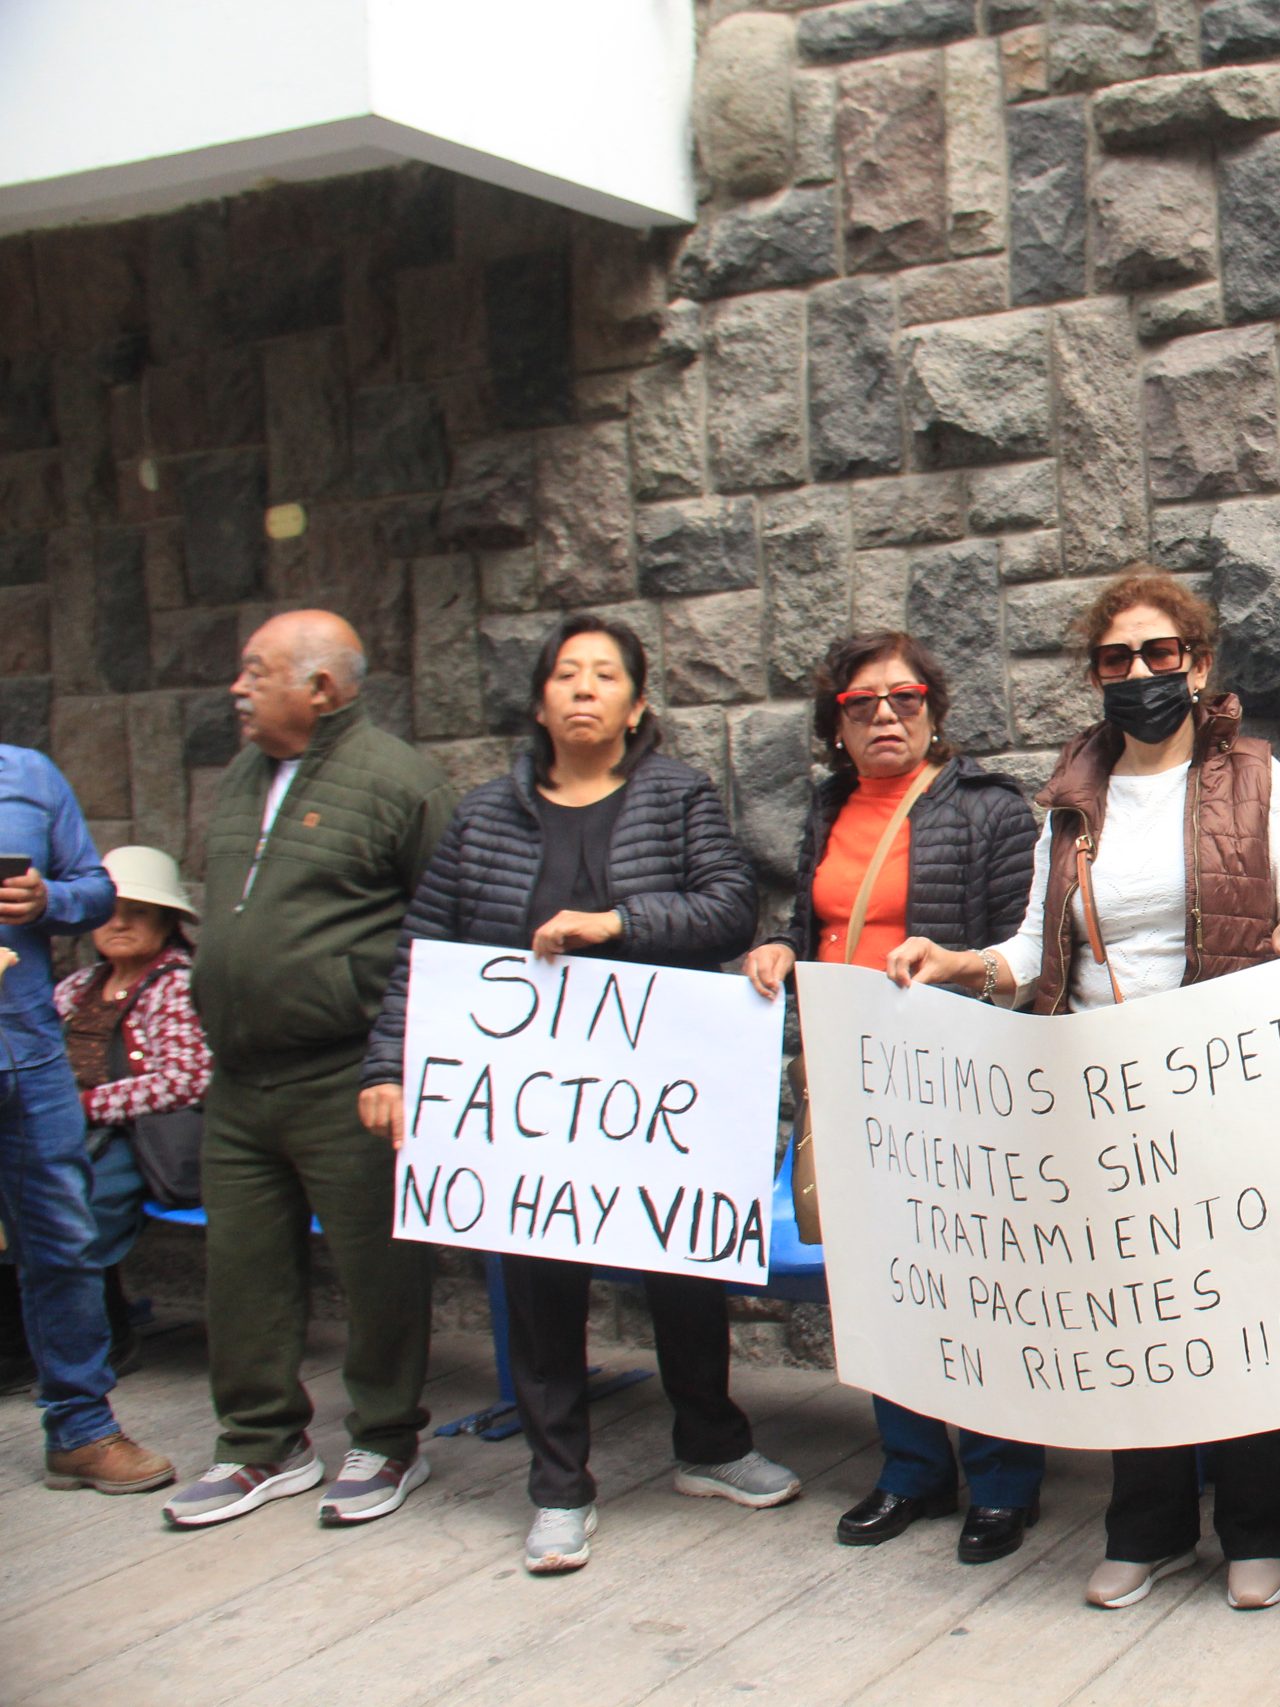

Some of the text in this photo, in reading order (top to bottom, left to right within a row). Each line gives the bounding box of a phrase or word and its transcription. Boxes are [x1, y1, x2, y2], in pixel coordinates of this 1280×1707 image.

[470, 955, 657, 1050] SIN
[411, 1056, 698, 1155] FACTOR
[401, 1164, 766, 1269] NO HAY VIDA
[890, 1256, 948, 1310] SON
[939, 1337, 984, 1387] EN
